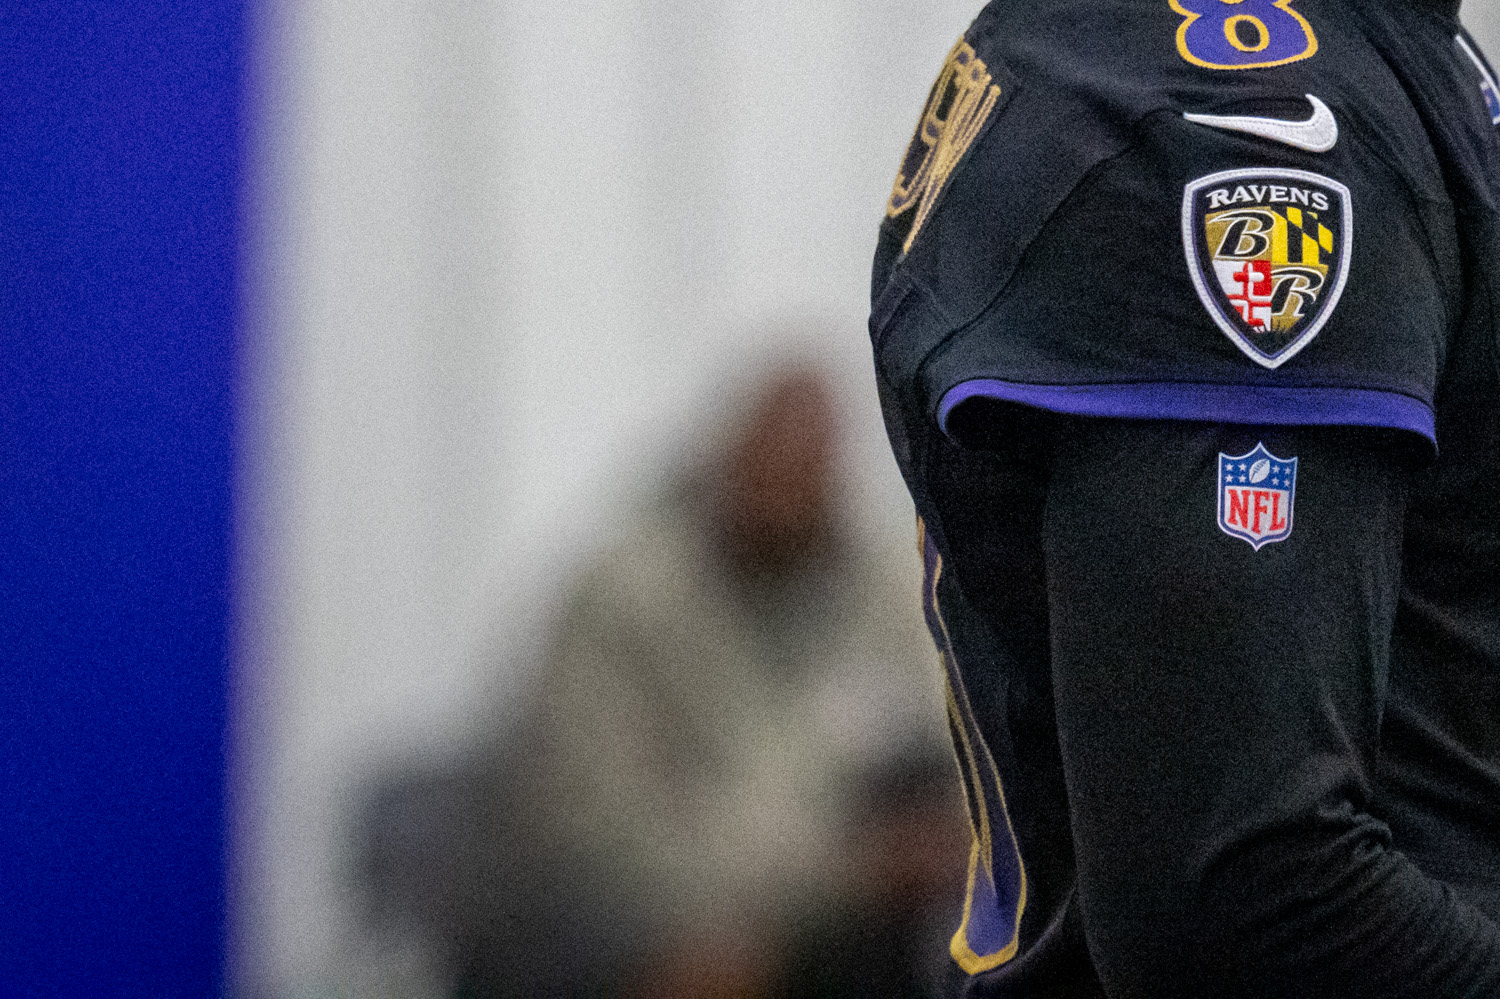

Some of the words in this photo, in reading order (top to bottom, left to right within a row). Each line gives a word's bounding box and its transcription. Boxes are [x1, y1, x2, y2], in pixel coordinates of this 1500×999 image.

[1206, 184, 1329, 211] RAVENS
[1208, 209, 1277, 261] B
[1271, 267, 1325, 318] R
[1227, 488, 1286, 535] NFL
